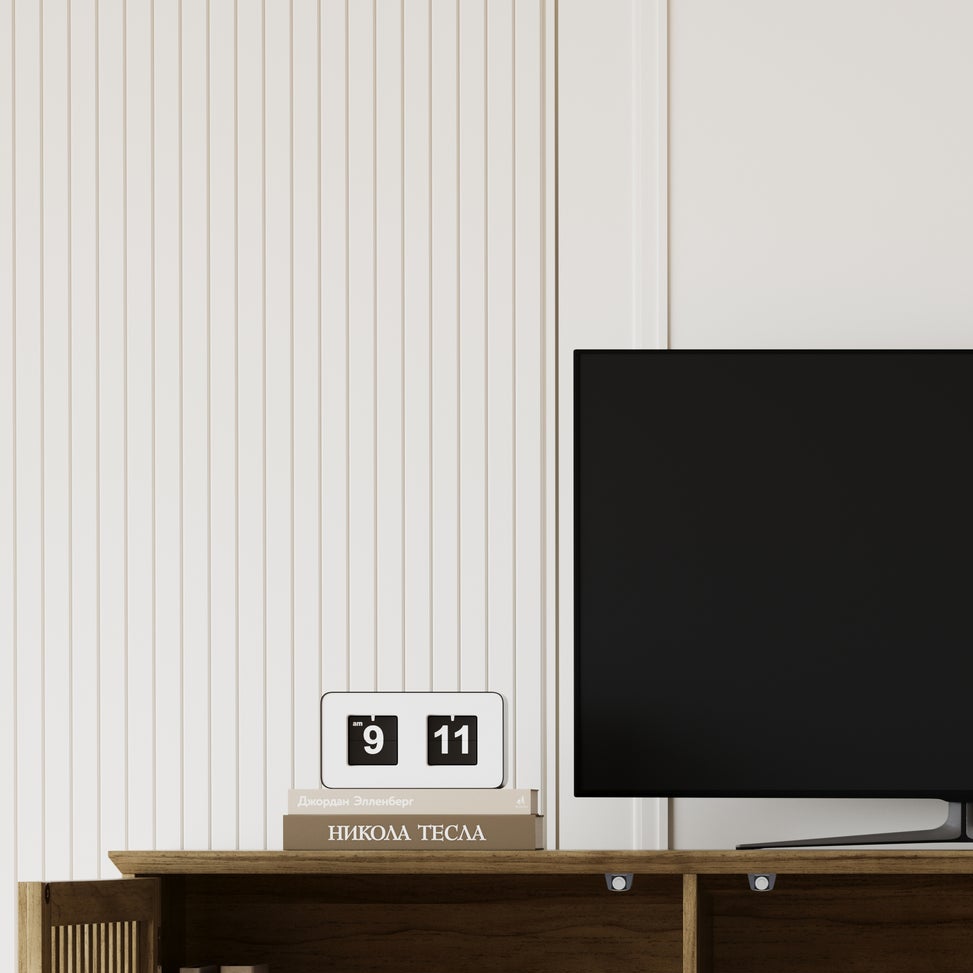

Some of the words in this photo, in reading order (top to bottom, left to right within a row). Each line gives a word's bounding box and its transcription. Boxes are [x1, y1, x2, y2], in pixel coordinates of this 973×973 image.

[363, 725, 384, 755] 9
[434, 725, 469, 754] 11
[297, 796, 349, 808] Джордан
[353, 796, 415, 808] Элленберг
[328, 825, 411, 841] НИКОЛА
[418, 824, 486, 842] ТЕСЛА
